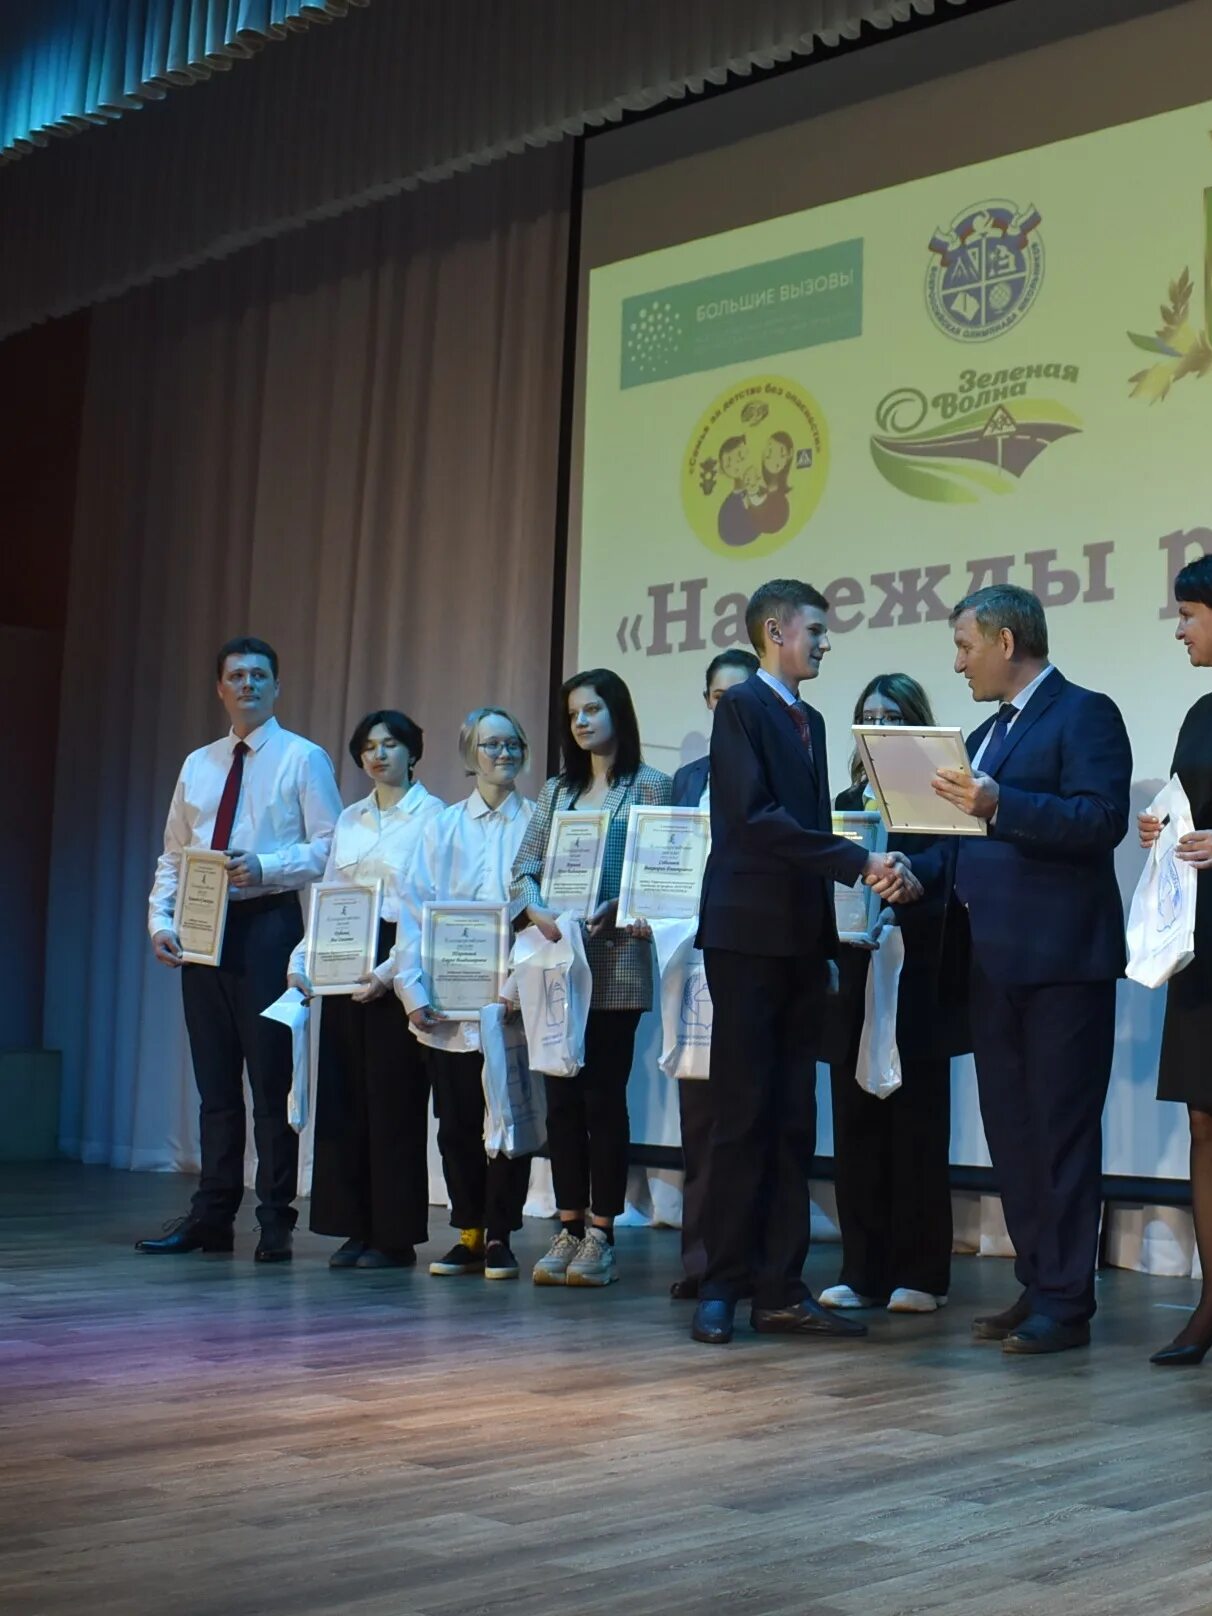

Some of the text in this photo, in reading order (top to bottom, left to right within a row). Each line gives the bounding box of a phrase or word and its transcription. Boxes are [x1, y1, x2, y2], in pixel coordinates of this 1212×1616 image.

[696, 269, 854, 322] БОЛЬШИЕ ВЫЗОВЫ
[931, 381, 1027, 419] Волна
[958, 363, 1080, 393] Зеленая
[616, 541, 1115, 656] «Наежды
